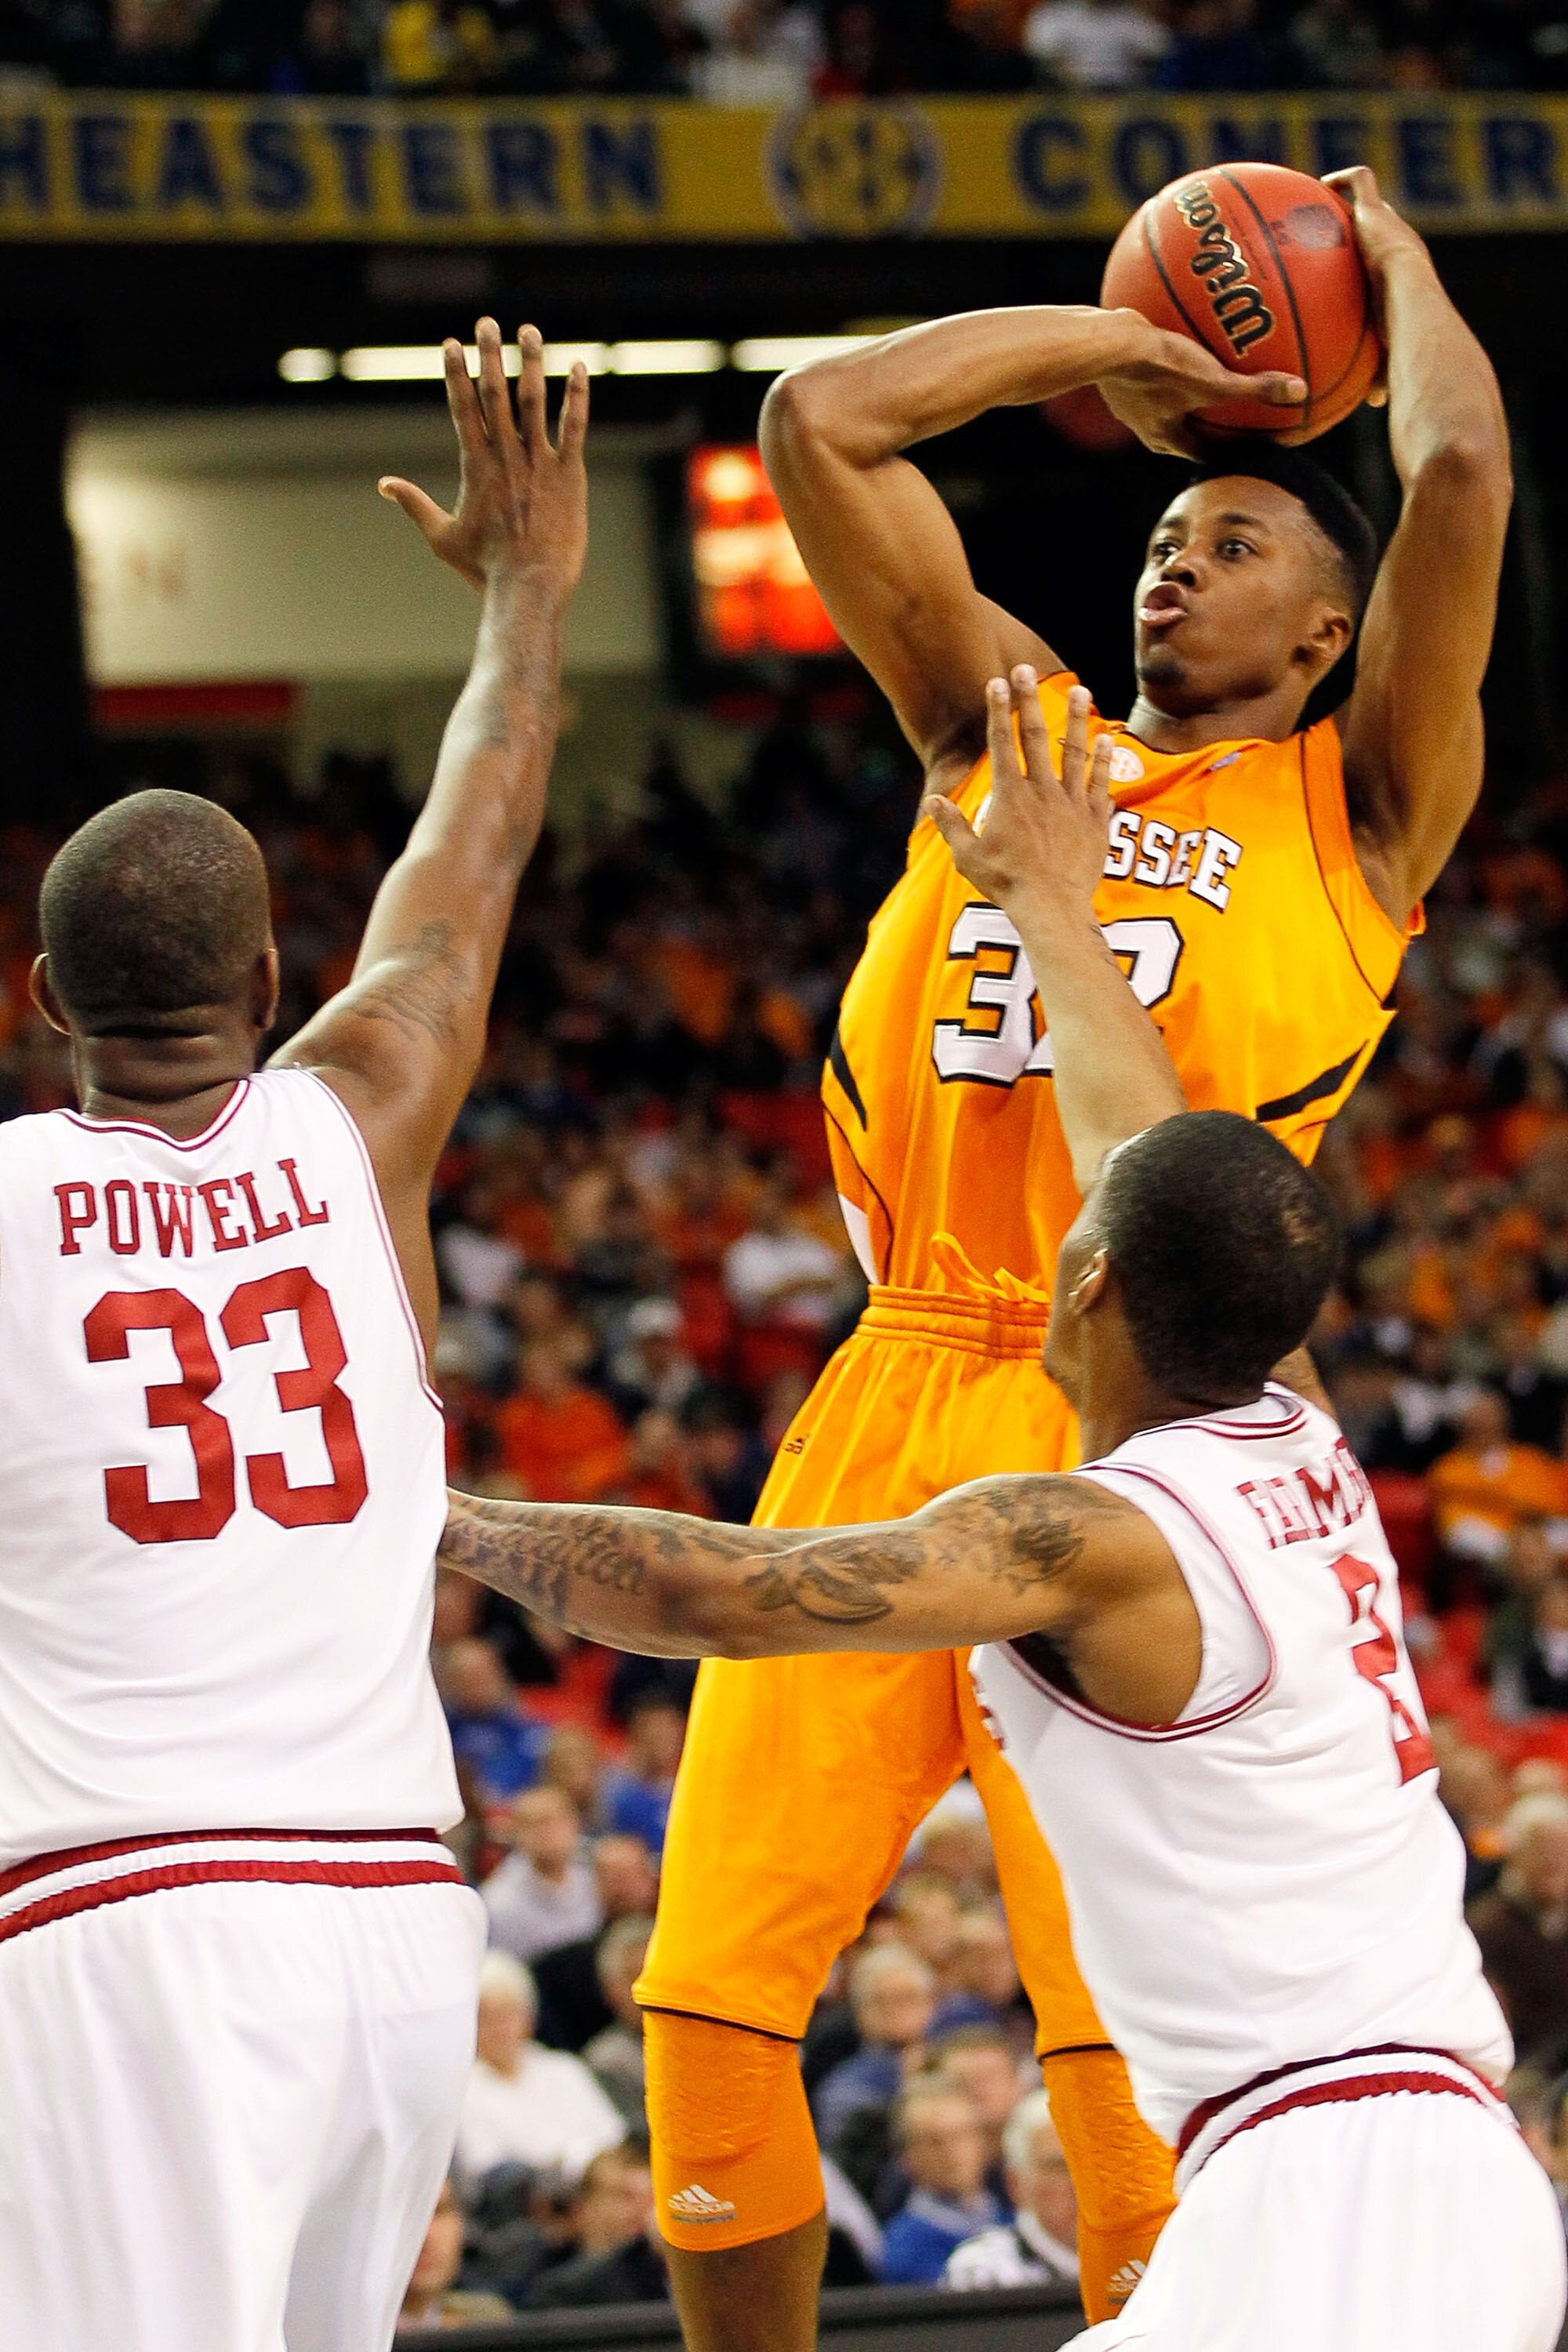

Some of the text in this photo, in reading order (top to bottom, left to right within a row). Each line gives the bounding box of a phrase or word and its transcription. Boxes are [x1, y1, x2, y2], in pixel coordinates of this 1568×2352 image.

[1174, 180, 1274, 359] Wilson
[53, 1157, 331, 1258] POWELL
[82, 1265, 370, 1545] 33
